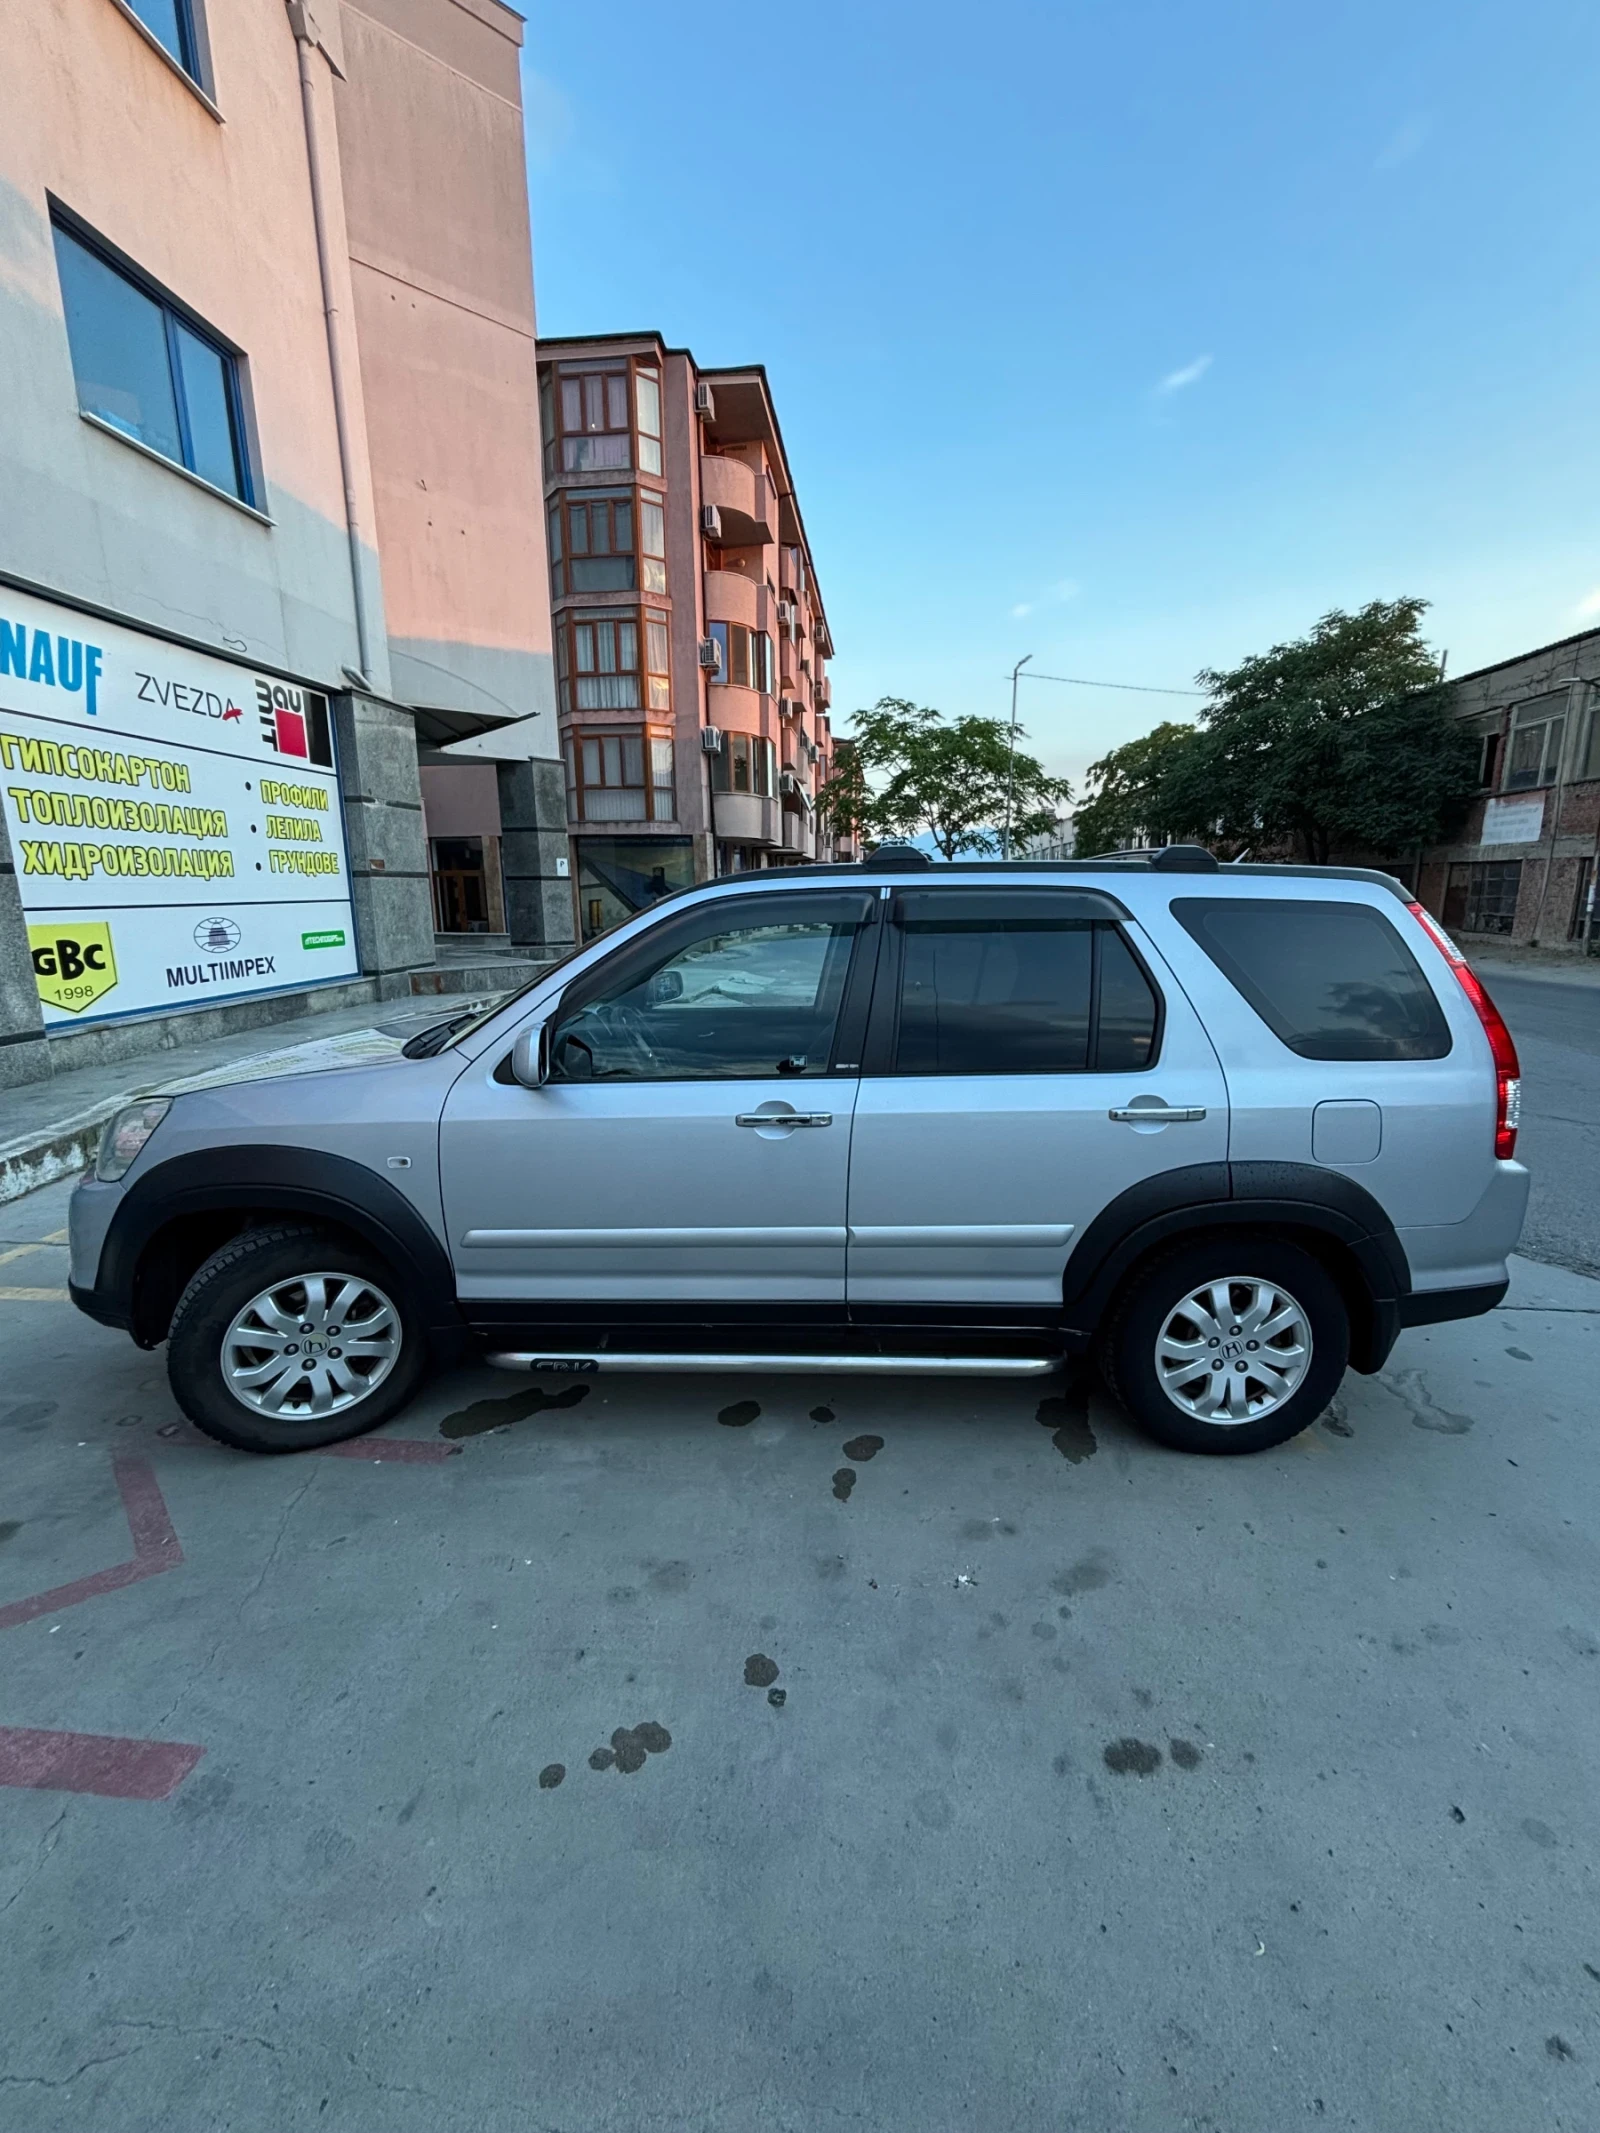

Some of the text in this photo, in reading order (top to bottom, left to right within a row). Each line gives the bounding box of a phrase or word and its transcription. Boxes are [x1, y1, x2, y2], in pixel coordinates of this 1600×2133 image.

[135, 671, 244, 725] ZVEZDA
[0, 733, 191, 793] ГИПСОКАРТОН
[260, 779, 329, 811] ПРОФИЛИ
[8, 787, 228, 840] ТОПЛОИЗОЛАЦИЯ
[266, 814, 323, 842] ЛЕПИЛА
[19, 840, 235, 881] ХИДРОИЗОЛАЦИЯ
[268, 849, 340, 877] ГРУНДОВЕ
[31, 939, 107, 981] GBC
[166, 956, 276, 988] MULTIIMPEX
[53, 985, 95, 1001] 1998
